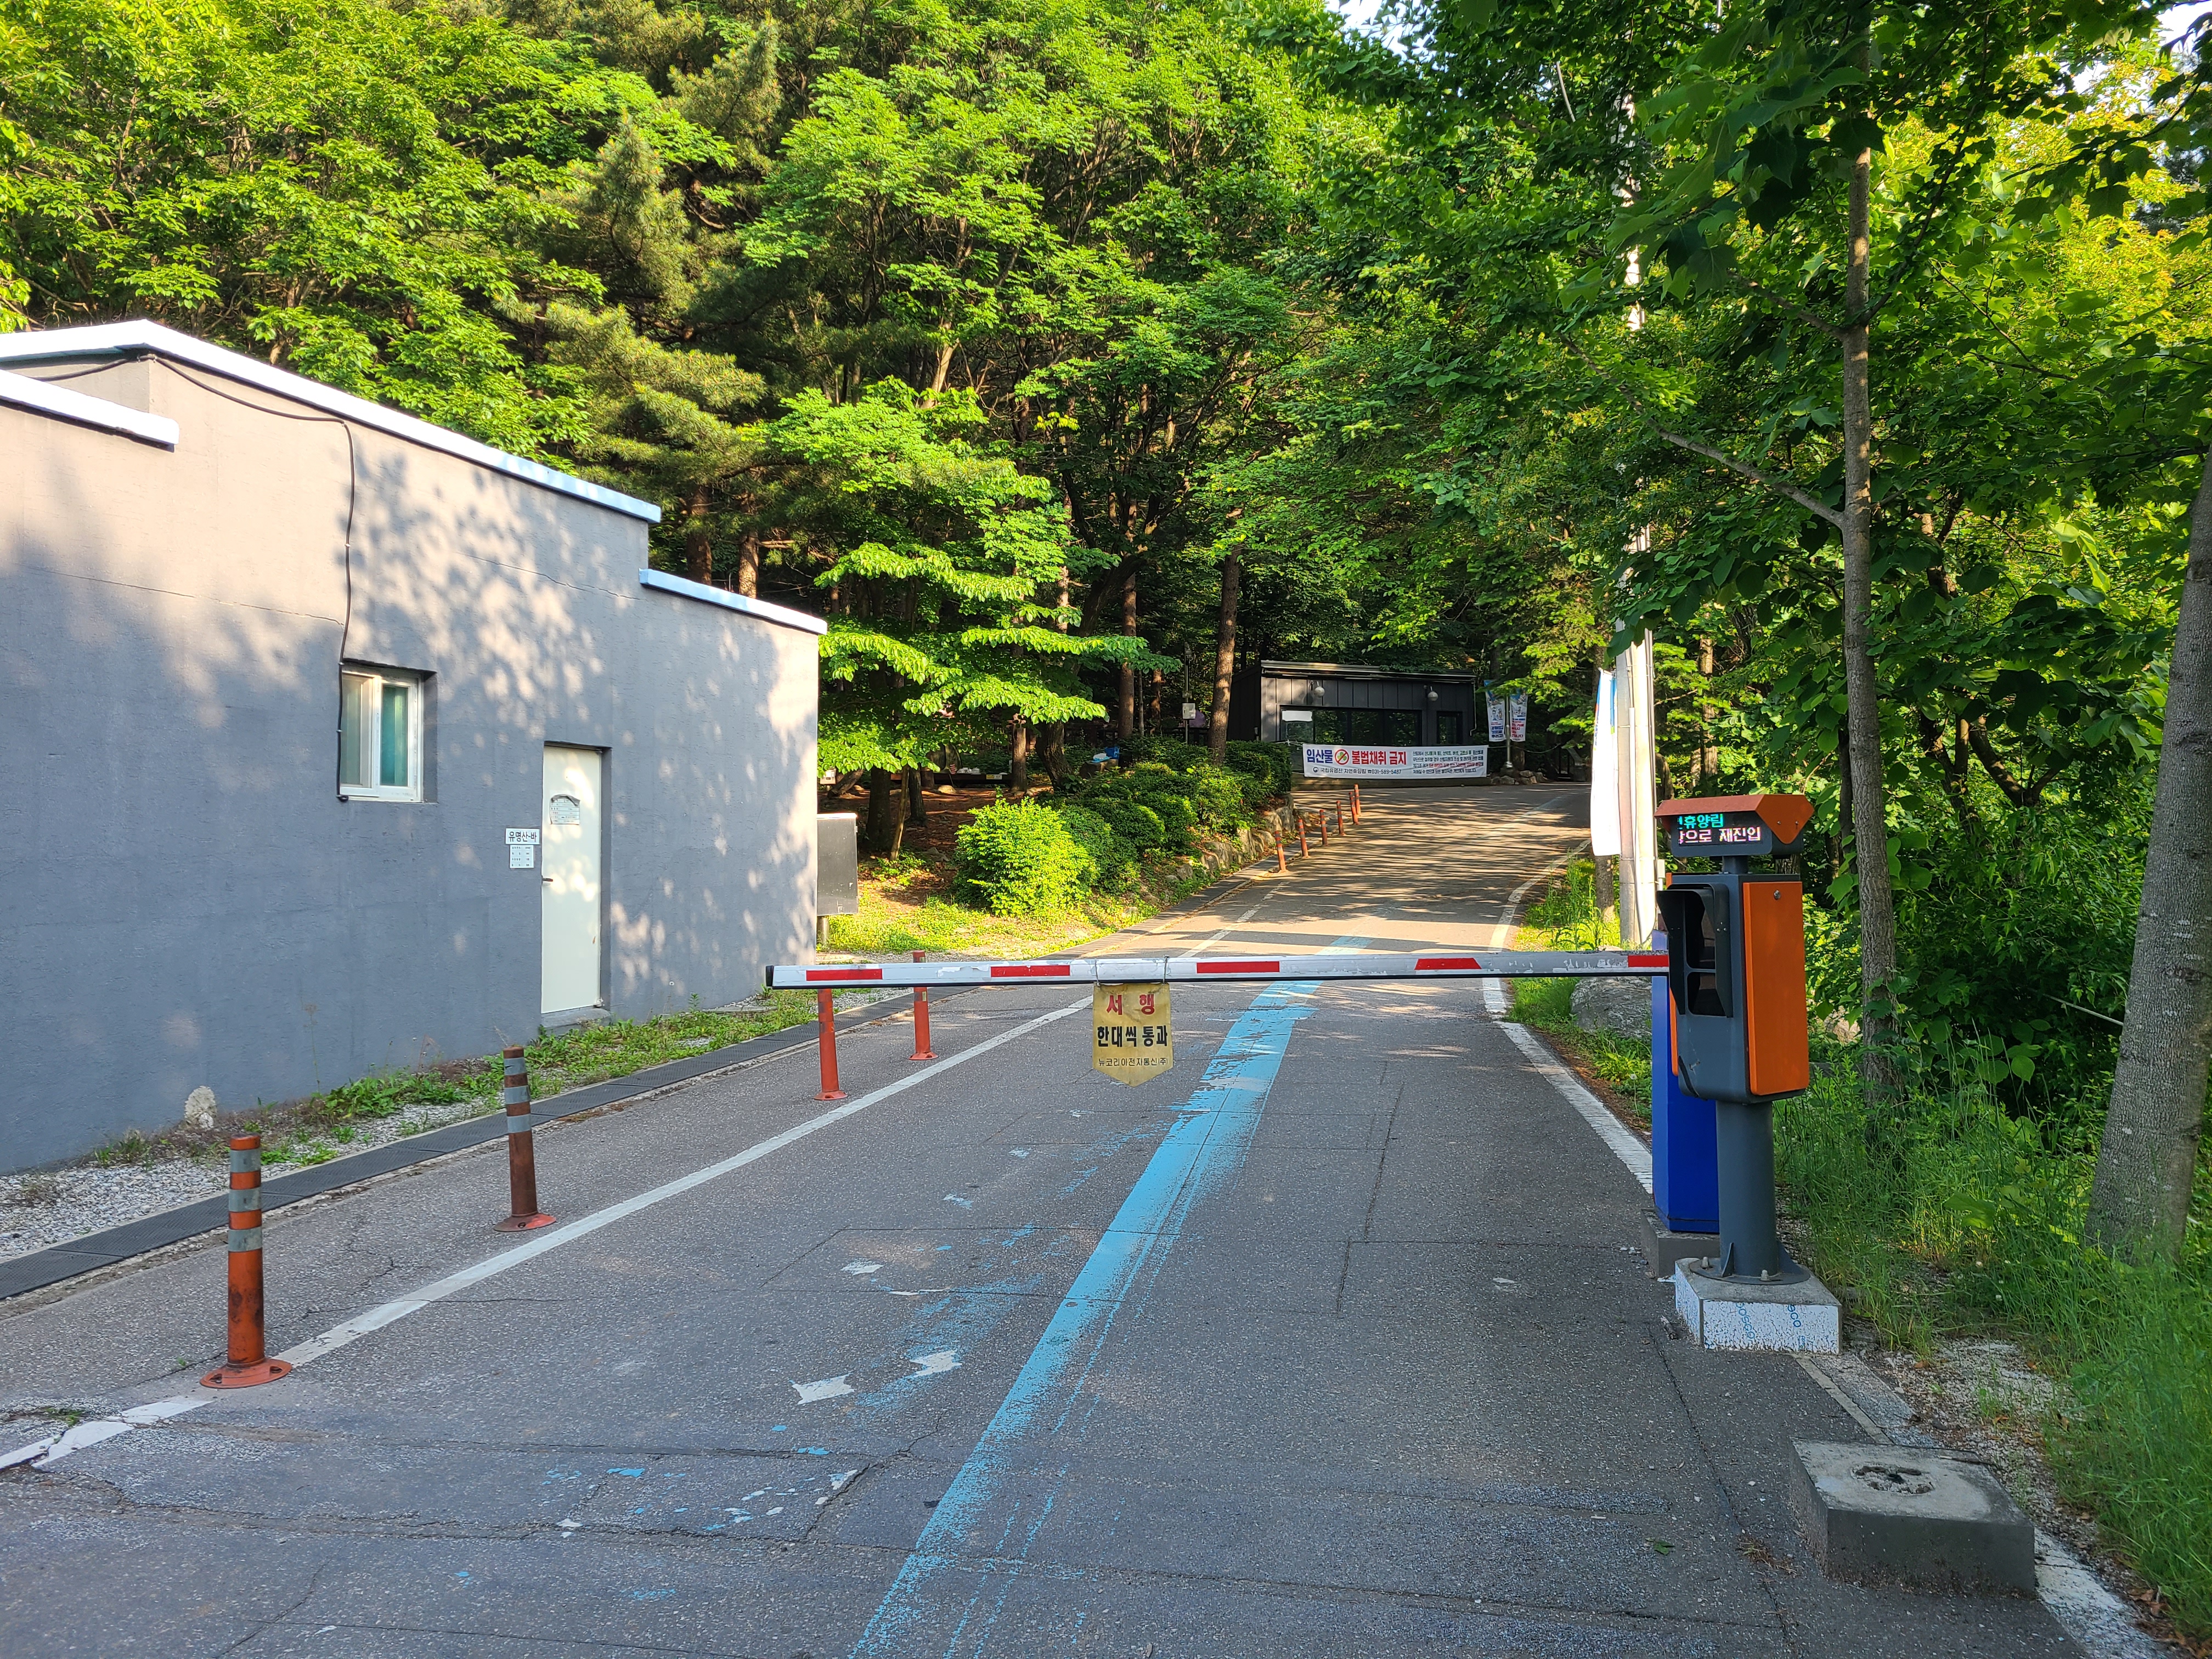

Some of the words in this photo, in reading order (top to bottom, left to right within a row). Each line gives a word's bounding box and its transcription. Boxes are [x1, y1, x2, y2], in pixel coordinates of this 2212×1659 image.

[1306, 749, 1333, 764] 임산물
[1352, 751, 1386, 765] 불법채취
[1389, 751, 1407, 765] 금지
[1678, 814, 1724, 830] 휴양림
[1718, 826, 1761, 842] 재진입
[1097, 1026, 1137, 1047] 한대씩
[1142, 1025, 1168, 1047] 통과
[1098, 1057, 1169, 1066] 뉴코리아전자통신(주)
